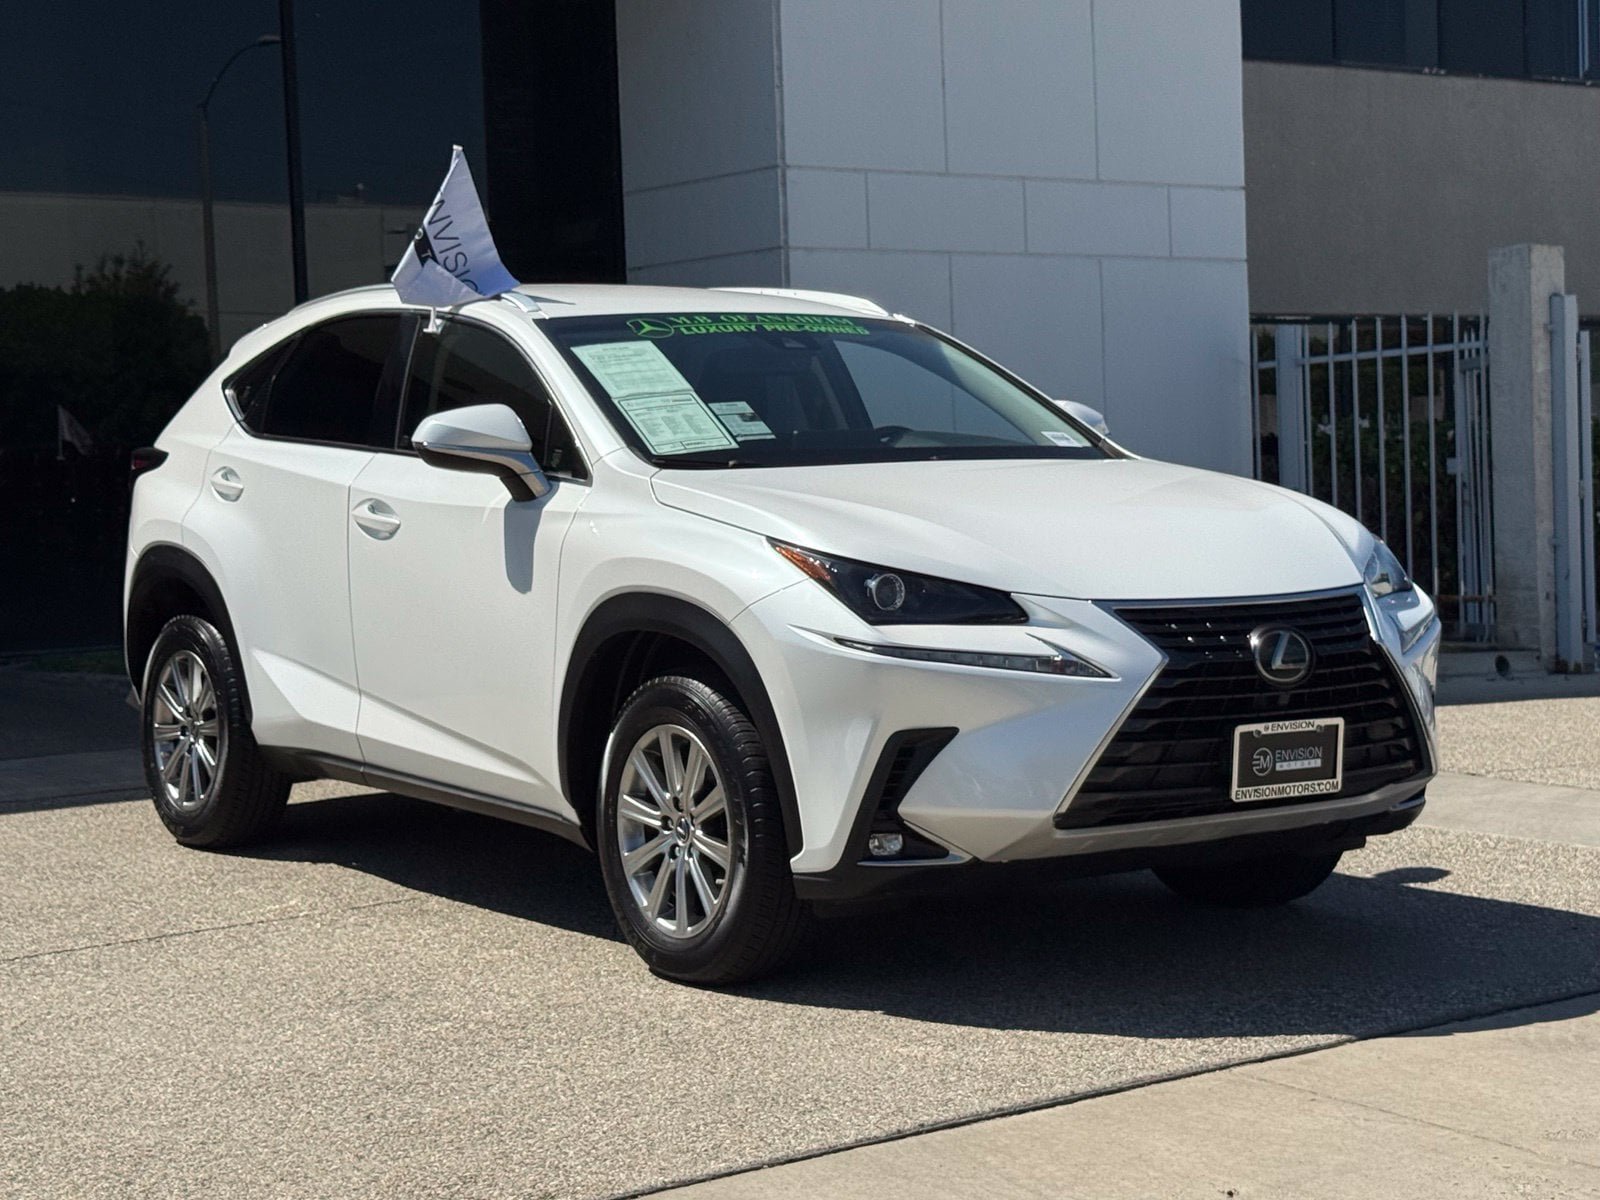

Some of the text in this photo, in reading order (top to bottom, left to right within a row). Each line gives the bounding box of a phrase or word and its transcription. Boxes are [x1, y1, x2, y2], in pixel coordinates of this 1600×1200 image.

[427, 190, 481, 294] NVISIO
[719, 314, 748, 323] OF
[755, 314, 855, 326] ANAHEIM
[679, 324, 871, 336] LUXURY PRE-OWNED
[1271, 720, 1315, 731] ENVISION
[1275, 746, 1322, 761] ENVISION
[1235, 780, 1339, 801] ENVISIONMOTORS.COM
